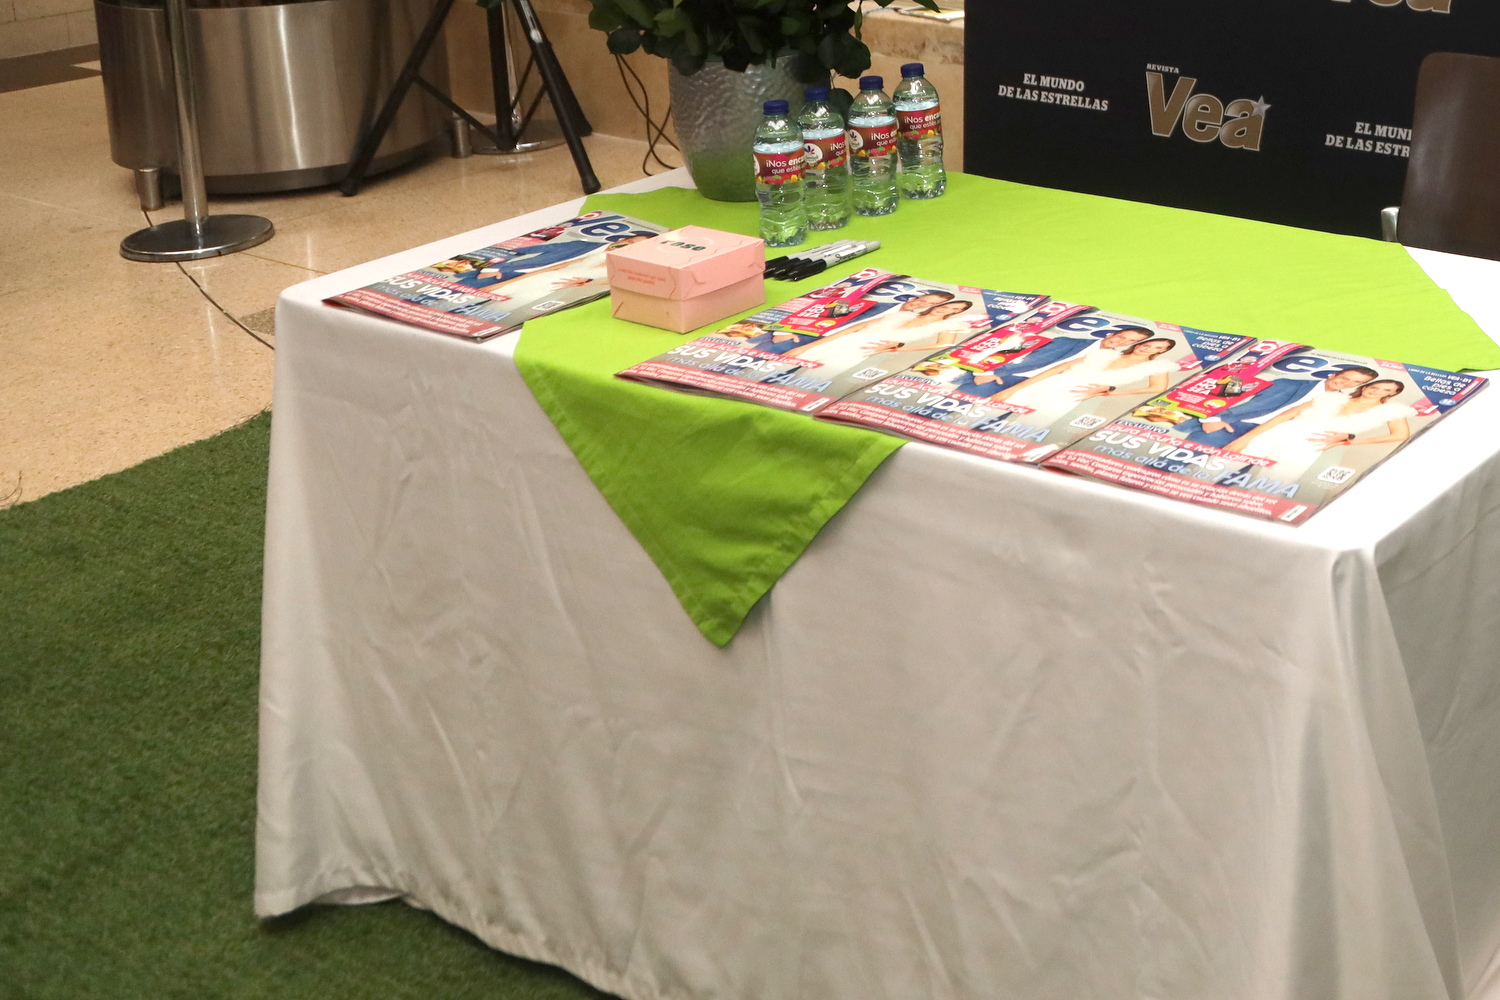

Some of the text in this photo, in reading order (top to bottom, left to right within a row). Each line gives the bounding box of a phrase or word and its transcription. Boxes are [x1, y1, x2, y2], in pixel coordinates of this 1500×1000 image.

[1146, 63, 1178, 73] REVISTA
[1145, 71, 1266, 152] Vea
[1325, 133, 1344, 147] DE
[1346, 137, 1373, 152] LAS
[1354, 121, 1412, 141] EL MUN
[416, 281, 476, 304] VIDAS
[667, 345, 780, 373] SUS VIDAS
[757, 369, 833, 394] FAMA
[865, 383, 992, 418] SUS VIDAS
[970, 416, 1051, 443] FAMA
[1089, 430, 1231, 471] SUS VIDAS
[1105, 424, 1140, 438] Laura
[1141, 431, 1183, 447] Acuña
[1223, 451, 1271, 467] Lalinde
[1093, 444, 1133, 460] más
[1135, 454, 1168, 469] allá
[1168, 462, 1191, 474] de
[1211, 468, 1301, 500] FAMA
